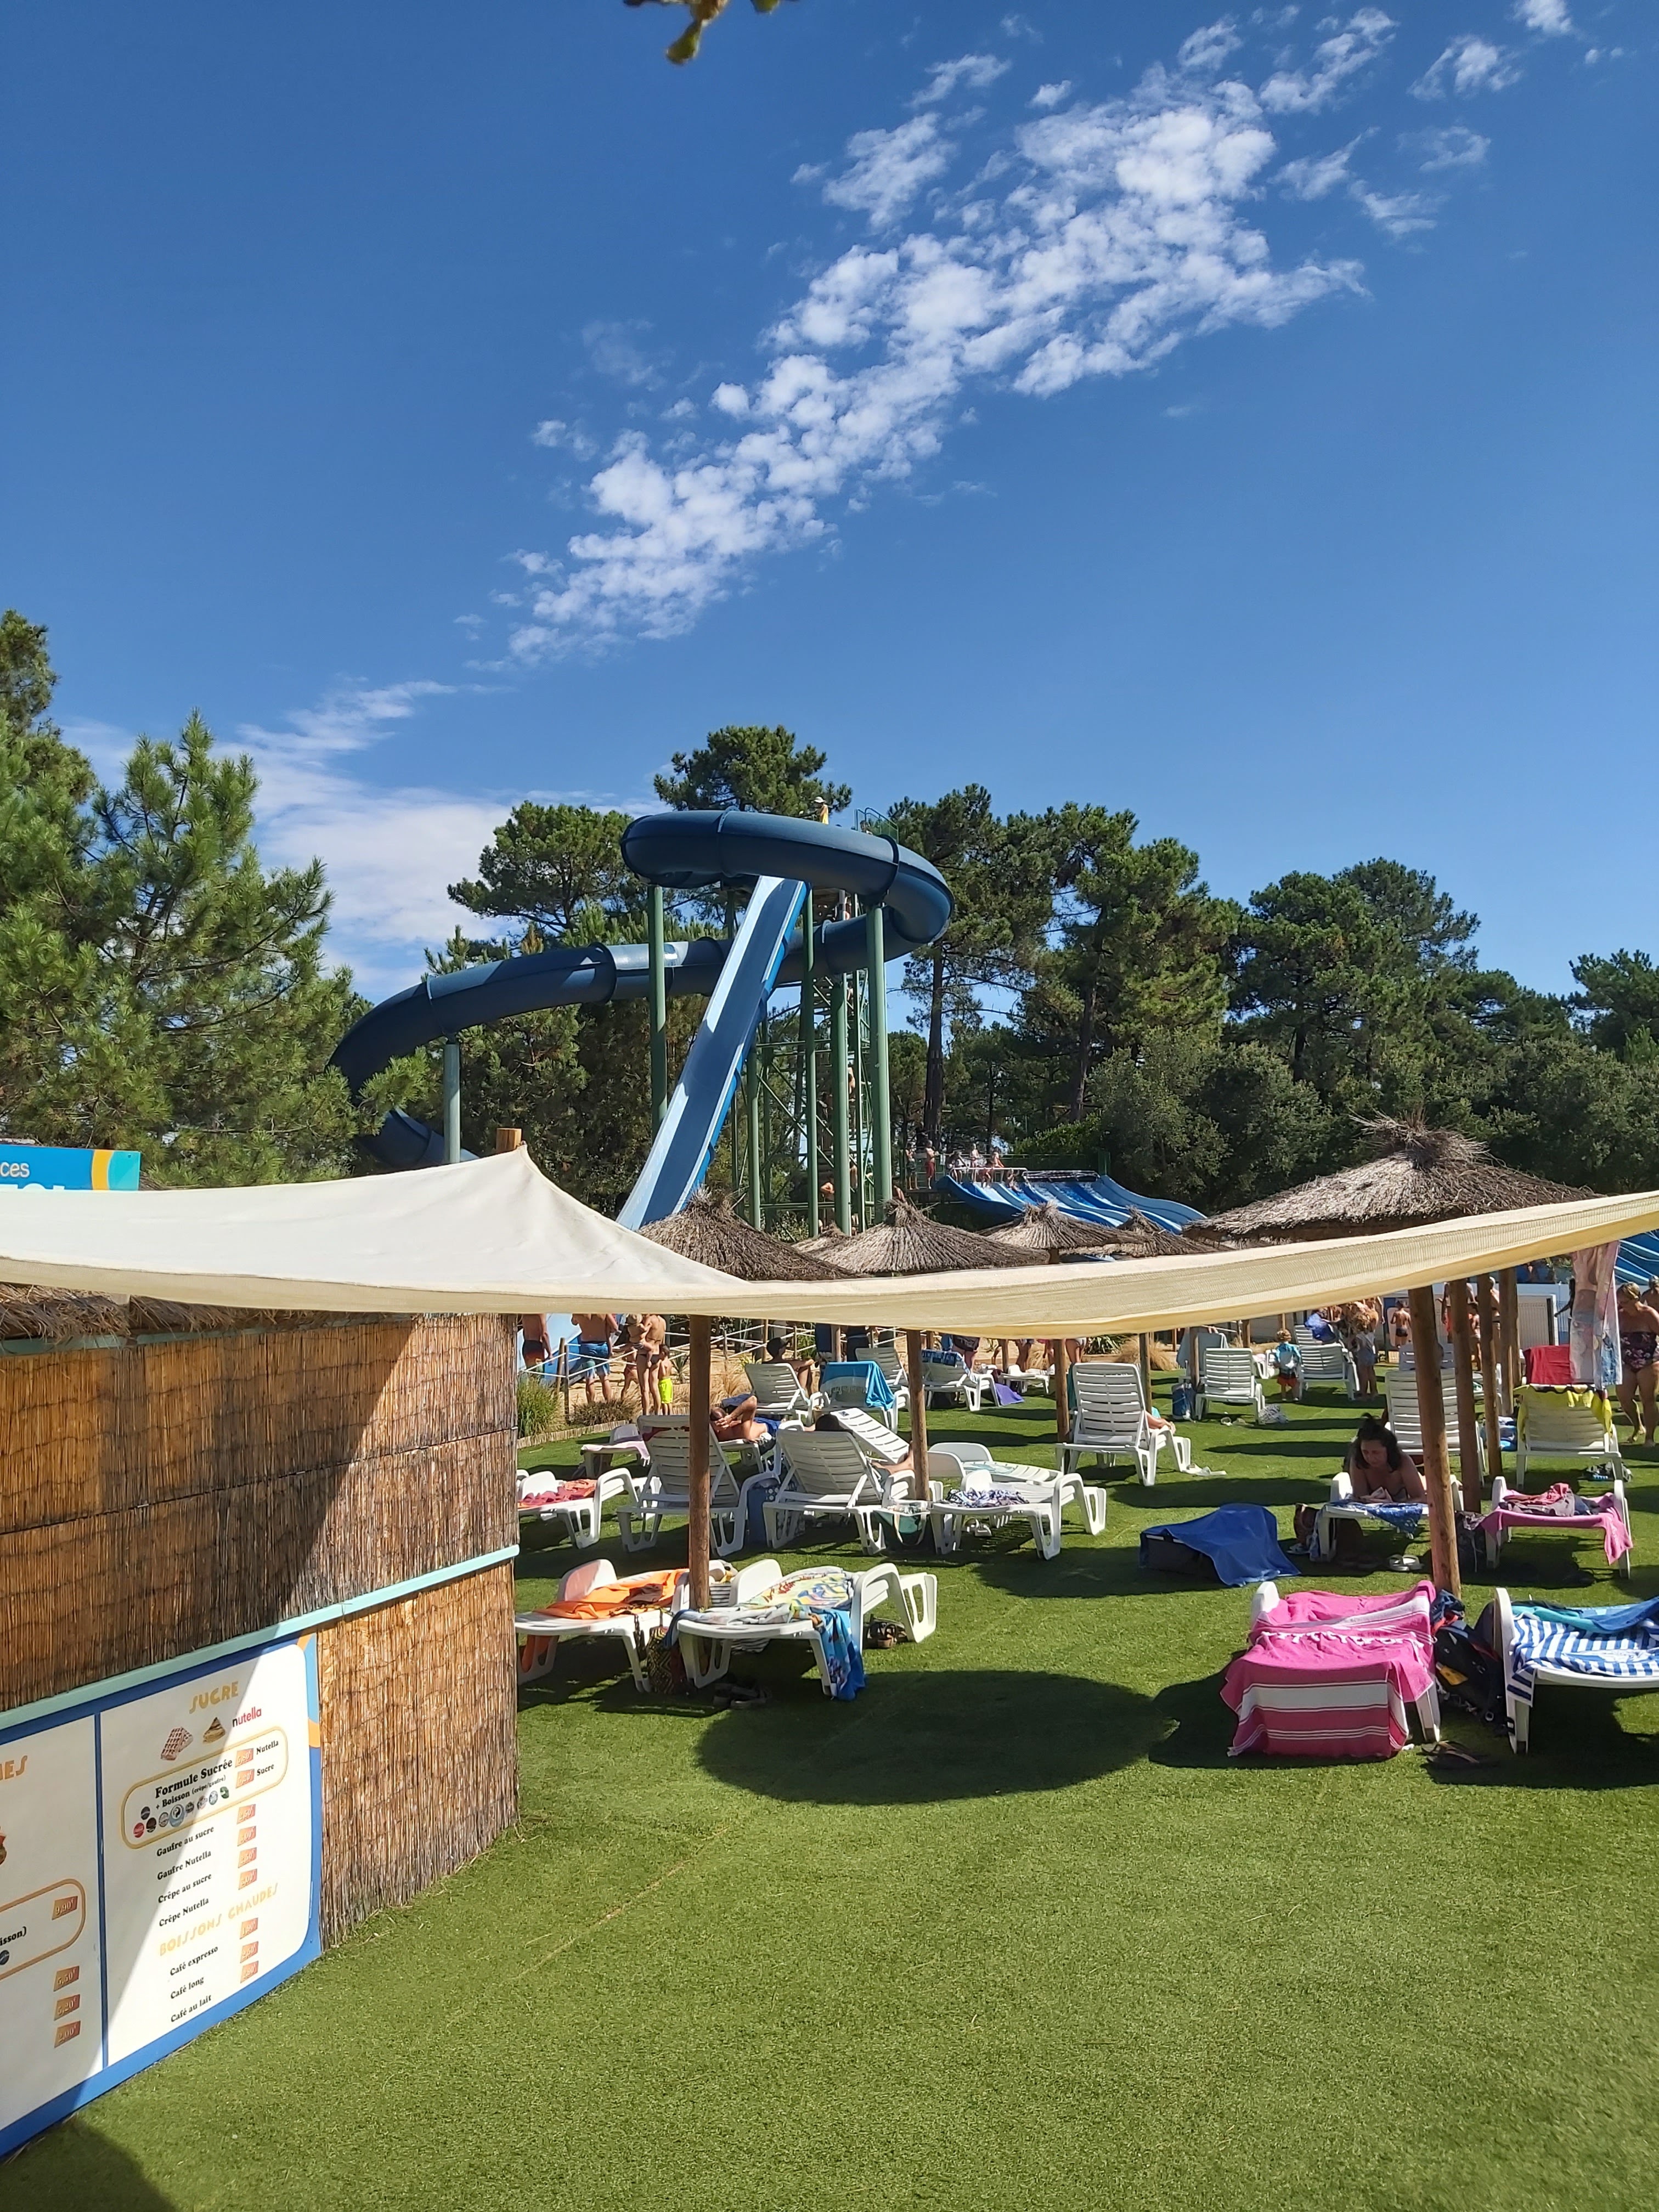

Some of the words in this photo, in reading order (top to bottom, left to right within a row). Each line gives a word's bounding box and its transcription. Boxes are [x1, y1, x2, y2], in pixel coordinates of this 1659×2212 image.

[0, 1161, 30, 1177] ces
[189, 1681, 239, 1714] SUCRE
[232, 1706, 262, 1728] nutella
[256, 1740, 279, 1754] Nutella
[155, 1774, 198, 1798] Formule
[200, 1759, 232, 1779] Sucrée
[257, 1764, 274, 1776] Sucre
[162, 1791, 190, 1807] Boisson
[156, 1841, 183, 1857] Gaufre
[184, 1836, 193, 1844] au
[195, 1827, 214, 1839] sucre
[157, 1864, 183, 1880] Gaufre
[185, 1850, 211, 1867] Nutella
[158, 1889, 180, 1903] Crêpe
[182, 1884, 191, 1892] au
[193, 1874, 212, 1887] sucre
[159, 1912, 181, 1927] Crêpe
[183, 1898, 209, 1916] Nutella
[160, 1914, 222, 1956] BOISSONS
[228, 1883, 278, 1919] CHAUDES
[0, 1926, 27, 1946] isson)
[170, 1961, 187, 1976] Café
[188, 1946, 218, 1966] expresso
[171, 1985, 187, 1999] Café
[188, 1977, 204, 1990] long
[171, 2008, 187, 2022] Café
[189, 2004, 198, 2013] au
[199, 1995, 212, 2007] lait
